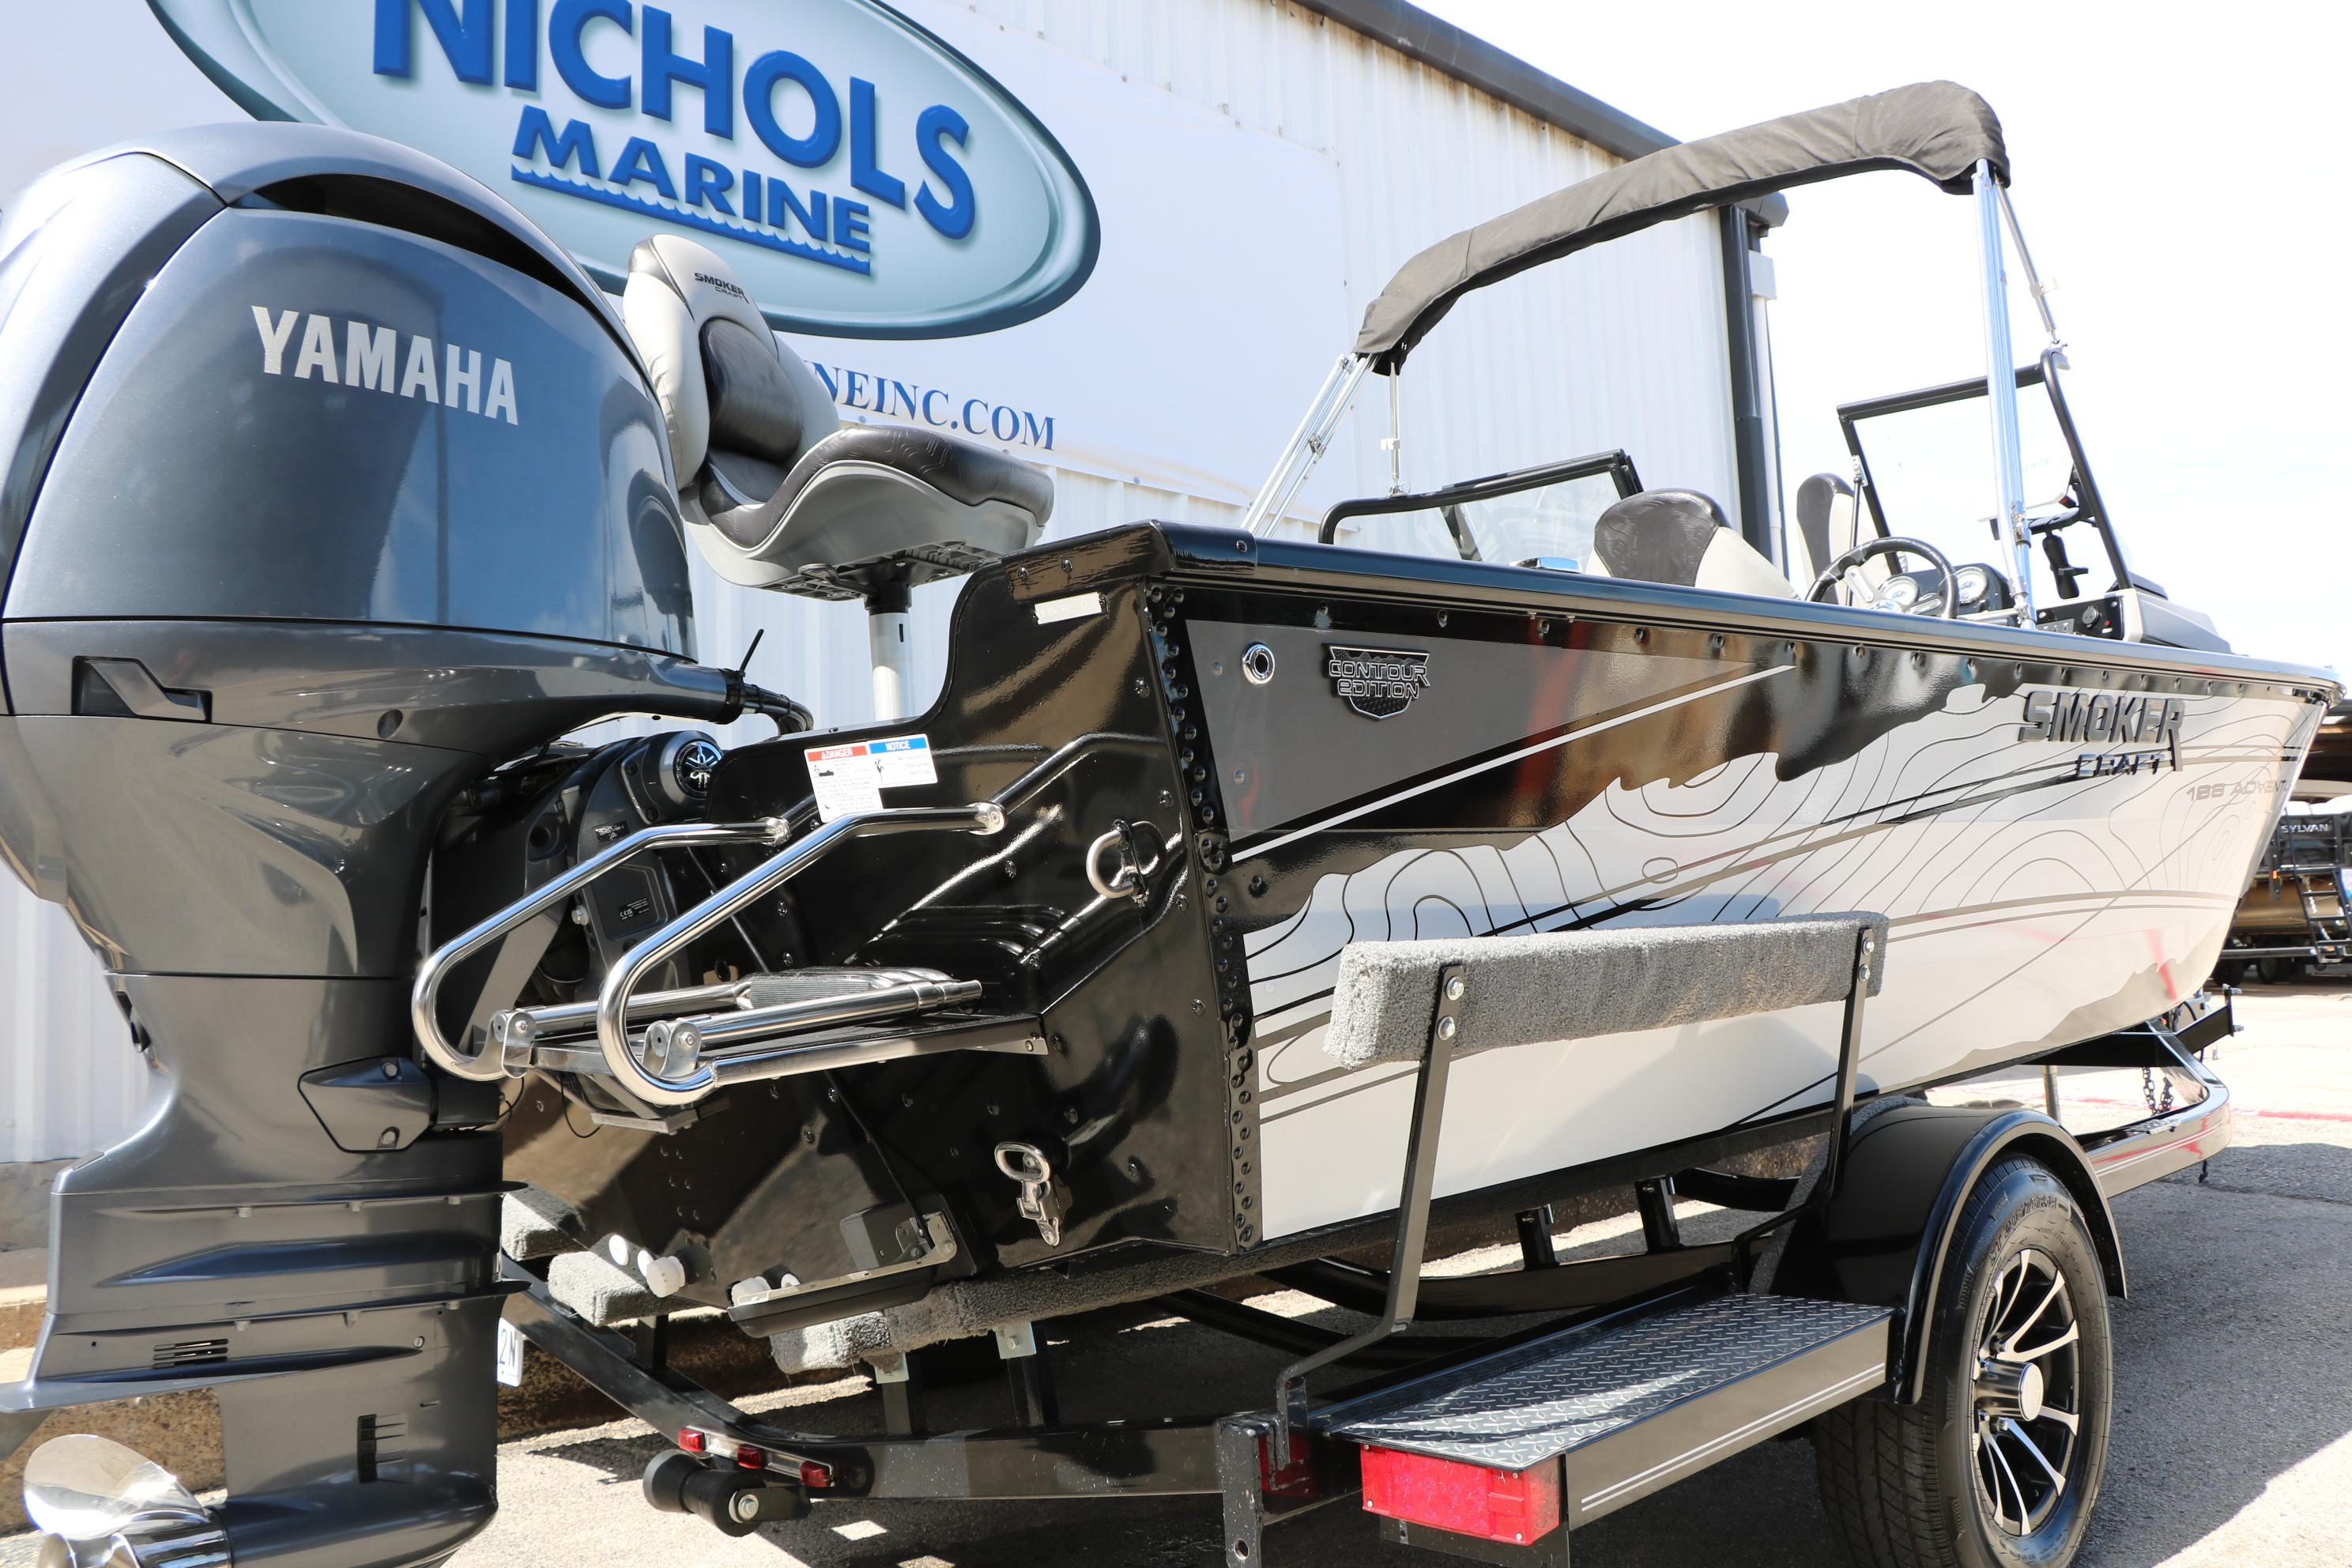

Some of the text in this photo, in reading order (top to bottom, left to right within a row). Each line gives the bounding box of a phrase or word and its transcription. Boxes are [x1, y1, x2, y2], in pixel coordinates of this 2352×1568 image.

[373, 0, 975, 239] NICHOLS
[511, 104, 870, 252] MARINE
[694, 272, 749, 304] SMOKER
[714, 286, 744, 300] CRAFT
[251, 305, 518, 426] YAMAHA
[1329, 659, 1430, 687] CONTOUR
[2018, 690, 2185, 772] SMOKER
[826, 748, 854, 760] DANGER
[885, 741, 910, 751] NOTICE
[2075, 753, 2165, 778] CRAFT
[2281, 824, 2329, 833] SYLVAN
